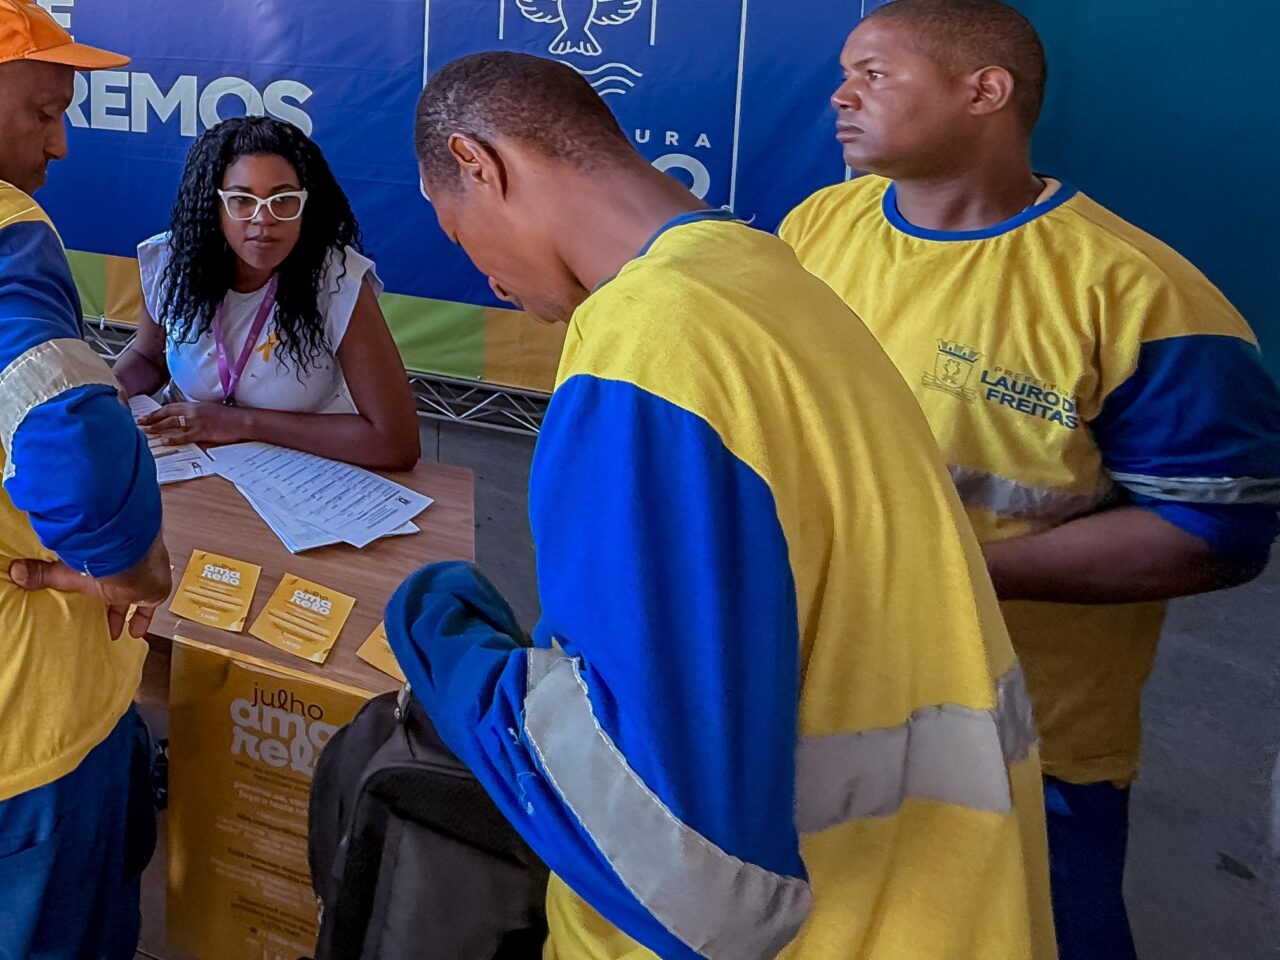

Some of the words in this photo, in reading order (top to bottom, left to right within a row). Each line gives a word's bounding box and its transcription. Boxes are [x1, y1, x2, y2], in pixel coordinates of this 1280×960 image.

[980, 369, 1061, 407] LAURO
[985, 387, 1079, 430] FREITAS
[251, 682, 324, 720] julho
[230, 725, 320, 777] rel
